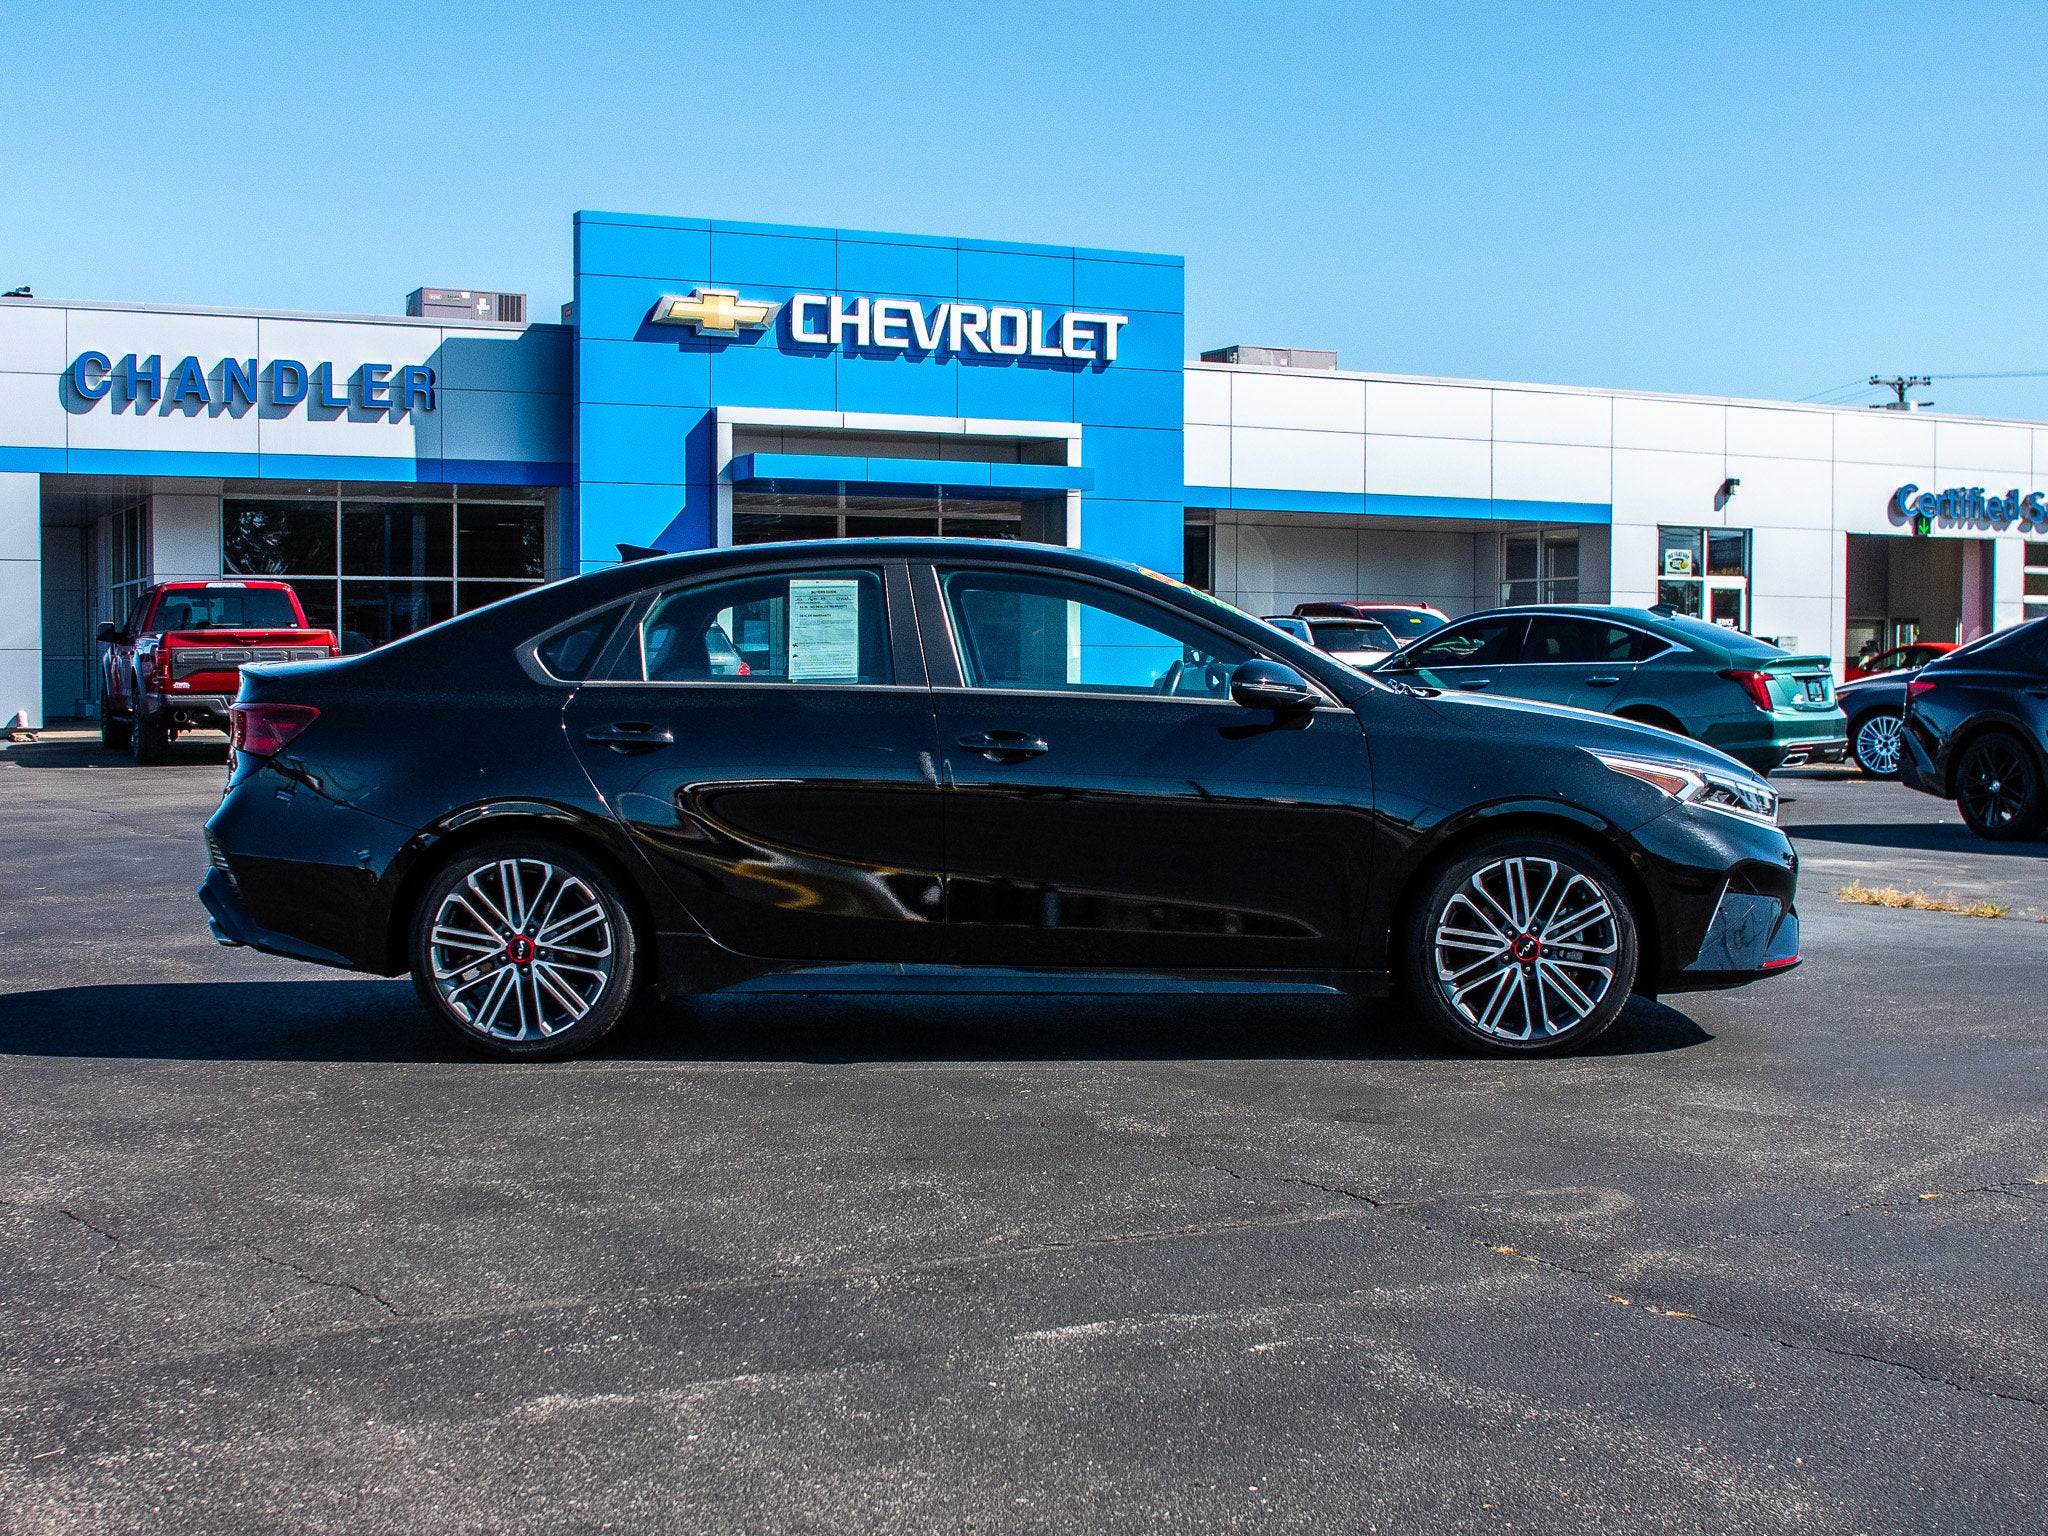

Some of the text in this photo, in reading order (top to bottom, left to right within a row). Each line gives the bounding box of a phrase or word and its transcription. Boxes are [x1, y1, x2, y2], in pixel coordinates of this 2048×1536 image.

[791, 293, 1129, 361] CHEVROLET
[73, 350, 437, 411] CHANDLER
[1899, 483, 2048, 523] Certified S
